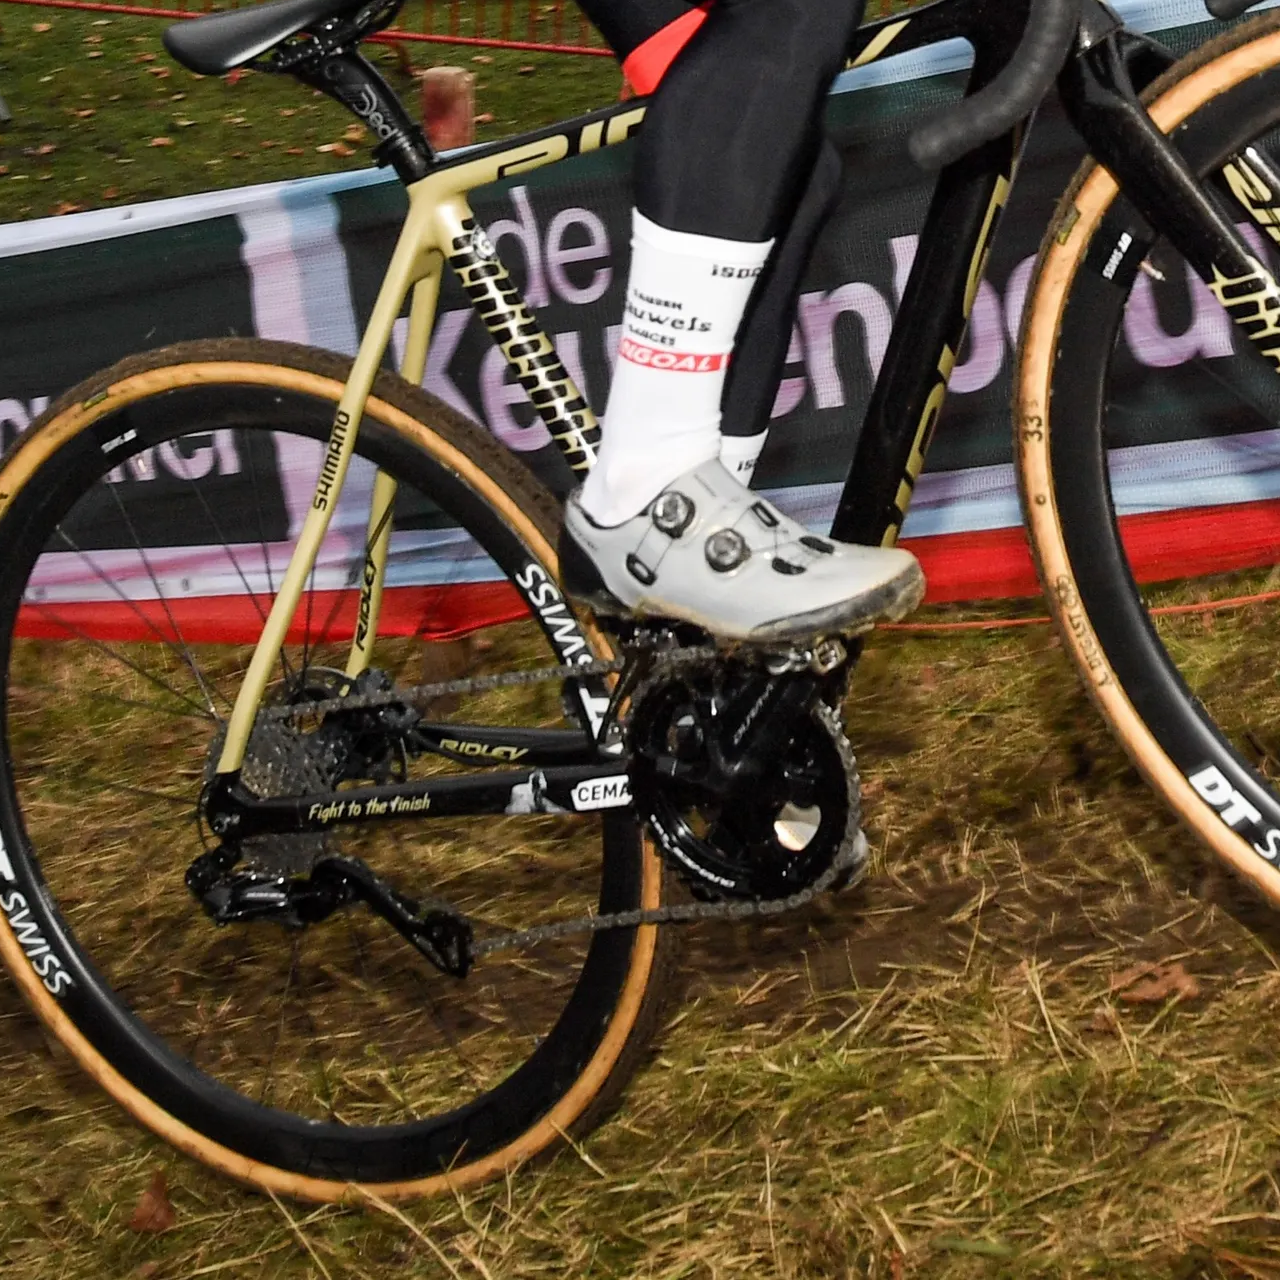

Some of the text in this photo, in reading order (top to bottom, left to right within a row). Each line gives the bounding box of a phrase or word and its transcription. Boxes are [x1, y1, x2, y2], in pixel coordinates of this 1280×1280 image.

[353, 83, 399, 141] Ded
[484, 185, 612, 309] de
[623, 342, 713, 372] NGOAL
[313, 410, 351, 511] SHIMANO
[354, 556, 378, 652] RIDLEY
[439, 739, 529, 762] RIDLEY
[309, 801, 347, 821] Fight
[348, 801, 363, 817] to
[366, 797, 389, 815] the
[1188, 765, 1263, 828] DT
